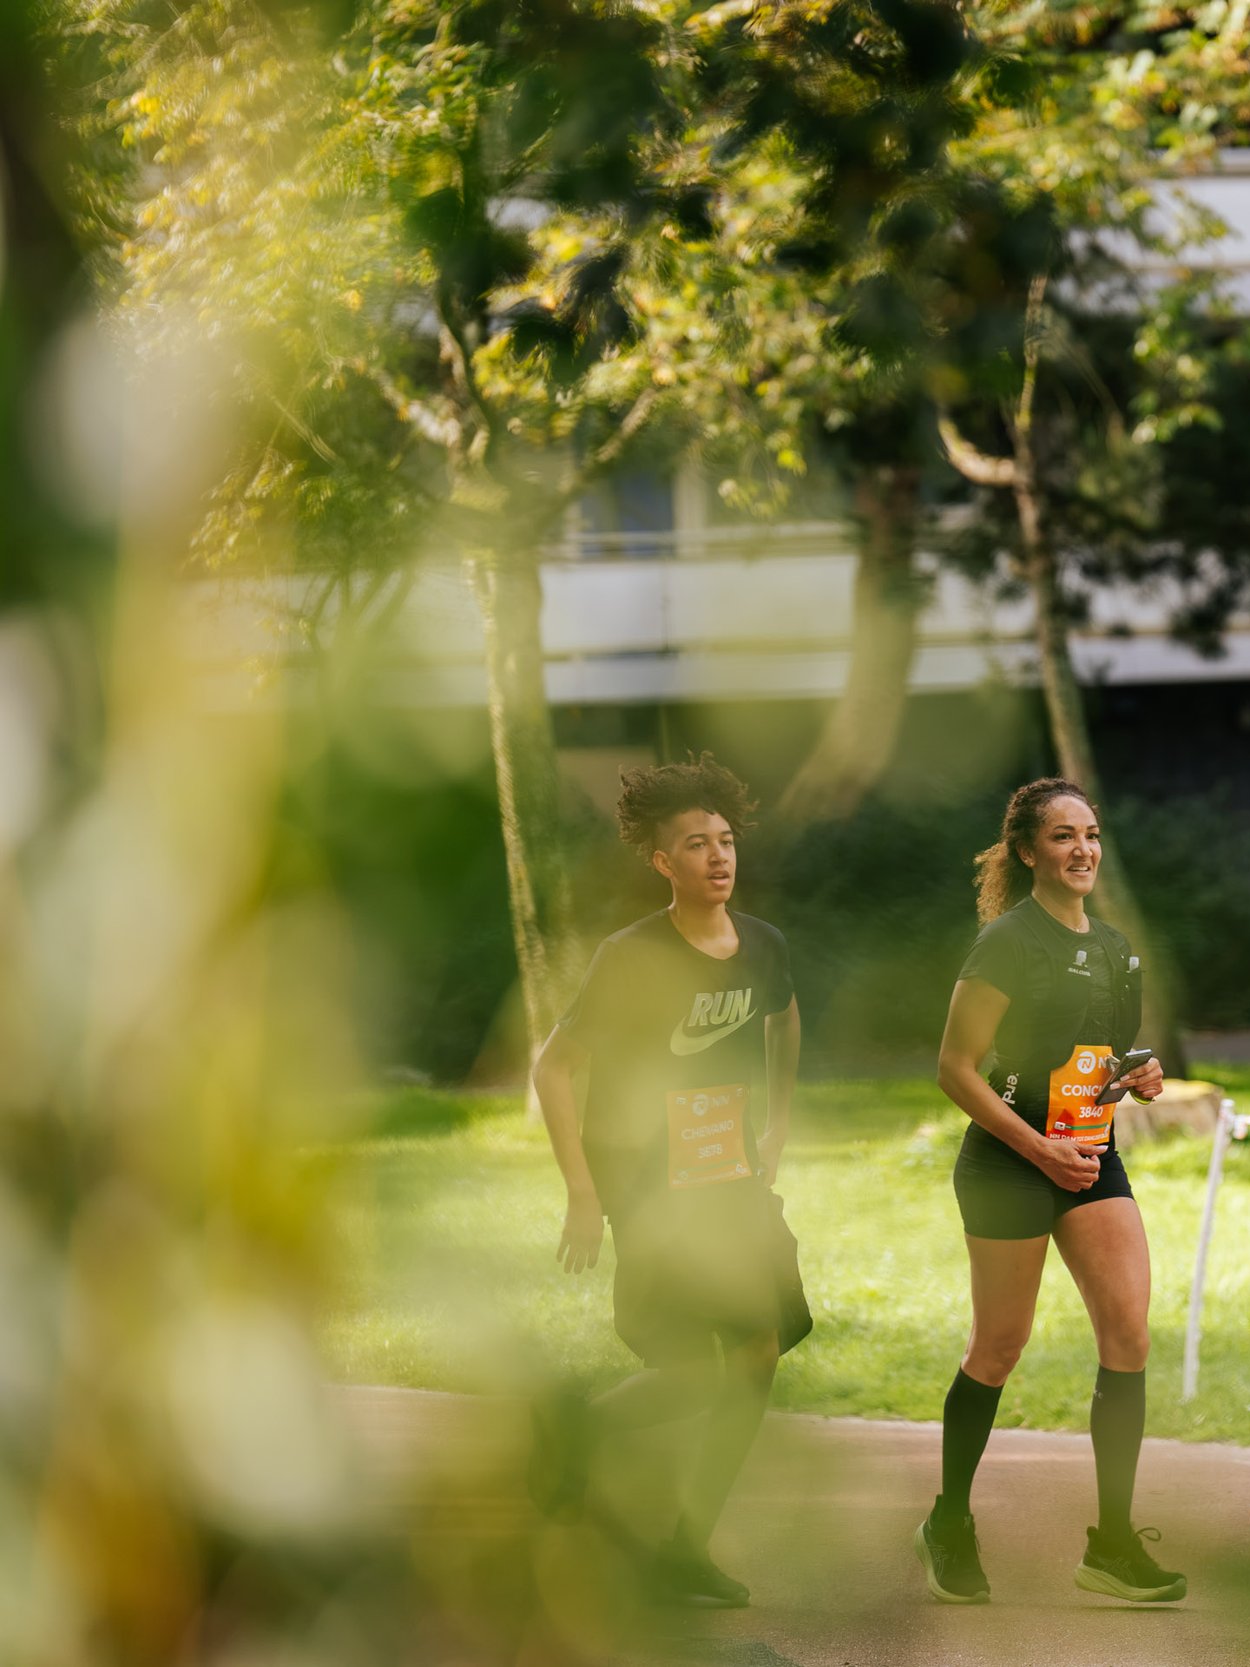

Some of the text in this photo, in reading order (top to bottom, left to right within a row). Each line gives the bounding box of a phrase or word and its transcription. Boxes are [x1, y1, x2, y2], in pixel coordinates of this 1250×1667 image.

[687, 988, 752, 1027] RUN
[1061, 1084, 1102, 1097] CONC
[1079, 1106, 1104, 1118] 3840
